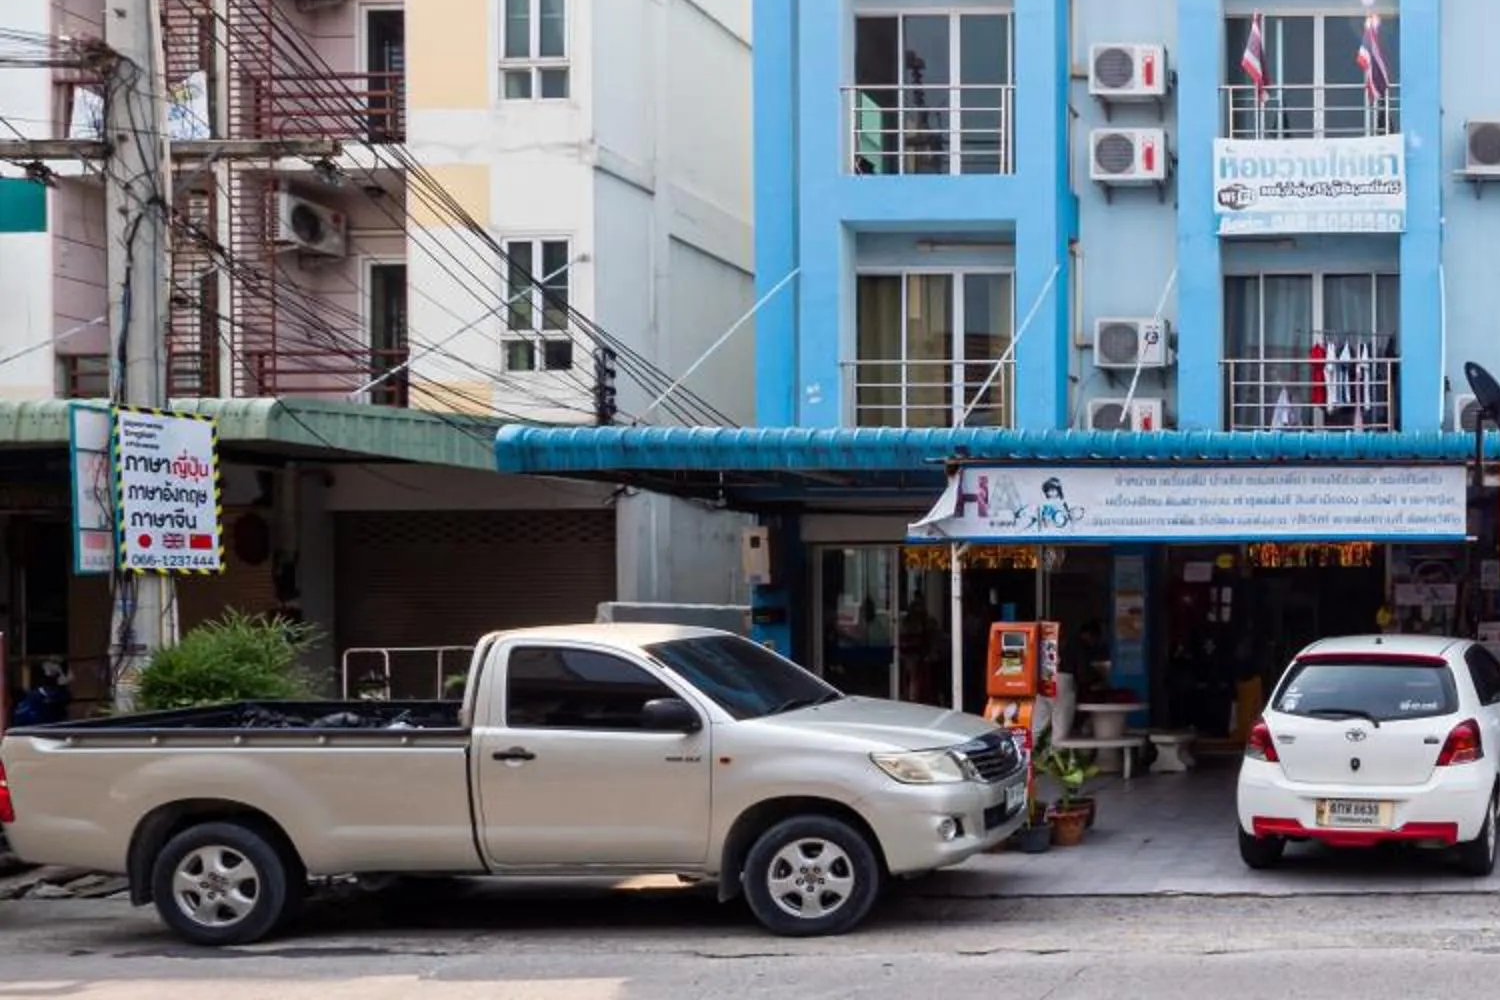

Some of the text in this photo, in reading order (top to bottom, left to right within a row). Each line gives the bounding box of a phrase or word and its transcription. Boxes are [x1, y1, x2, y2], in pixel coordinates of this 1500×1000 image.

[127, 481, 208, 508] ภาษาอังกฤษ
[130, 508, 198, 529] ภาษาจีน
